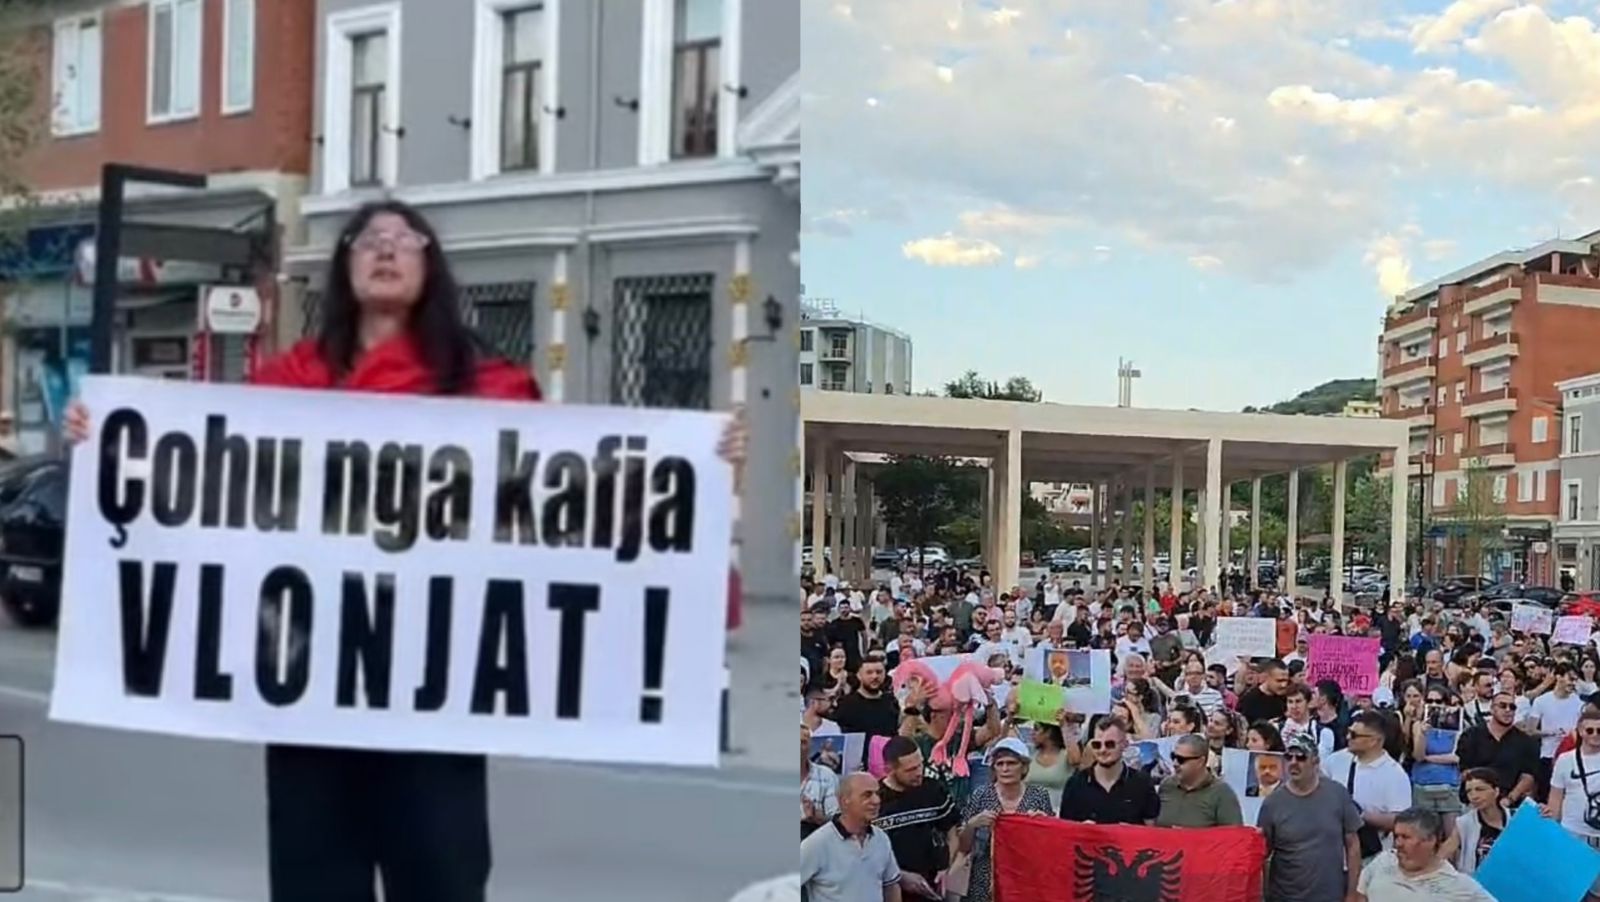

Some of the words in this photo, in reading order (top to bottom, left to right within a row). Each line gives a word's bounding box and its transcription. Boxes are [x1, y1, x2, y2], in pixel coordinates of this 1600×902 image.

[97, 408, 302, 550] Çohu
[321, 440, 474, 554] nga
[493, 429, 697, 564] kafja
